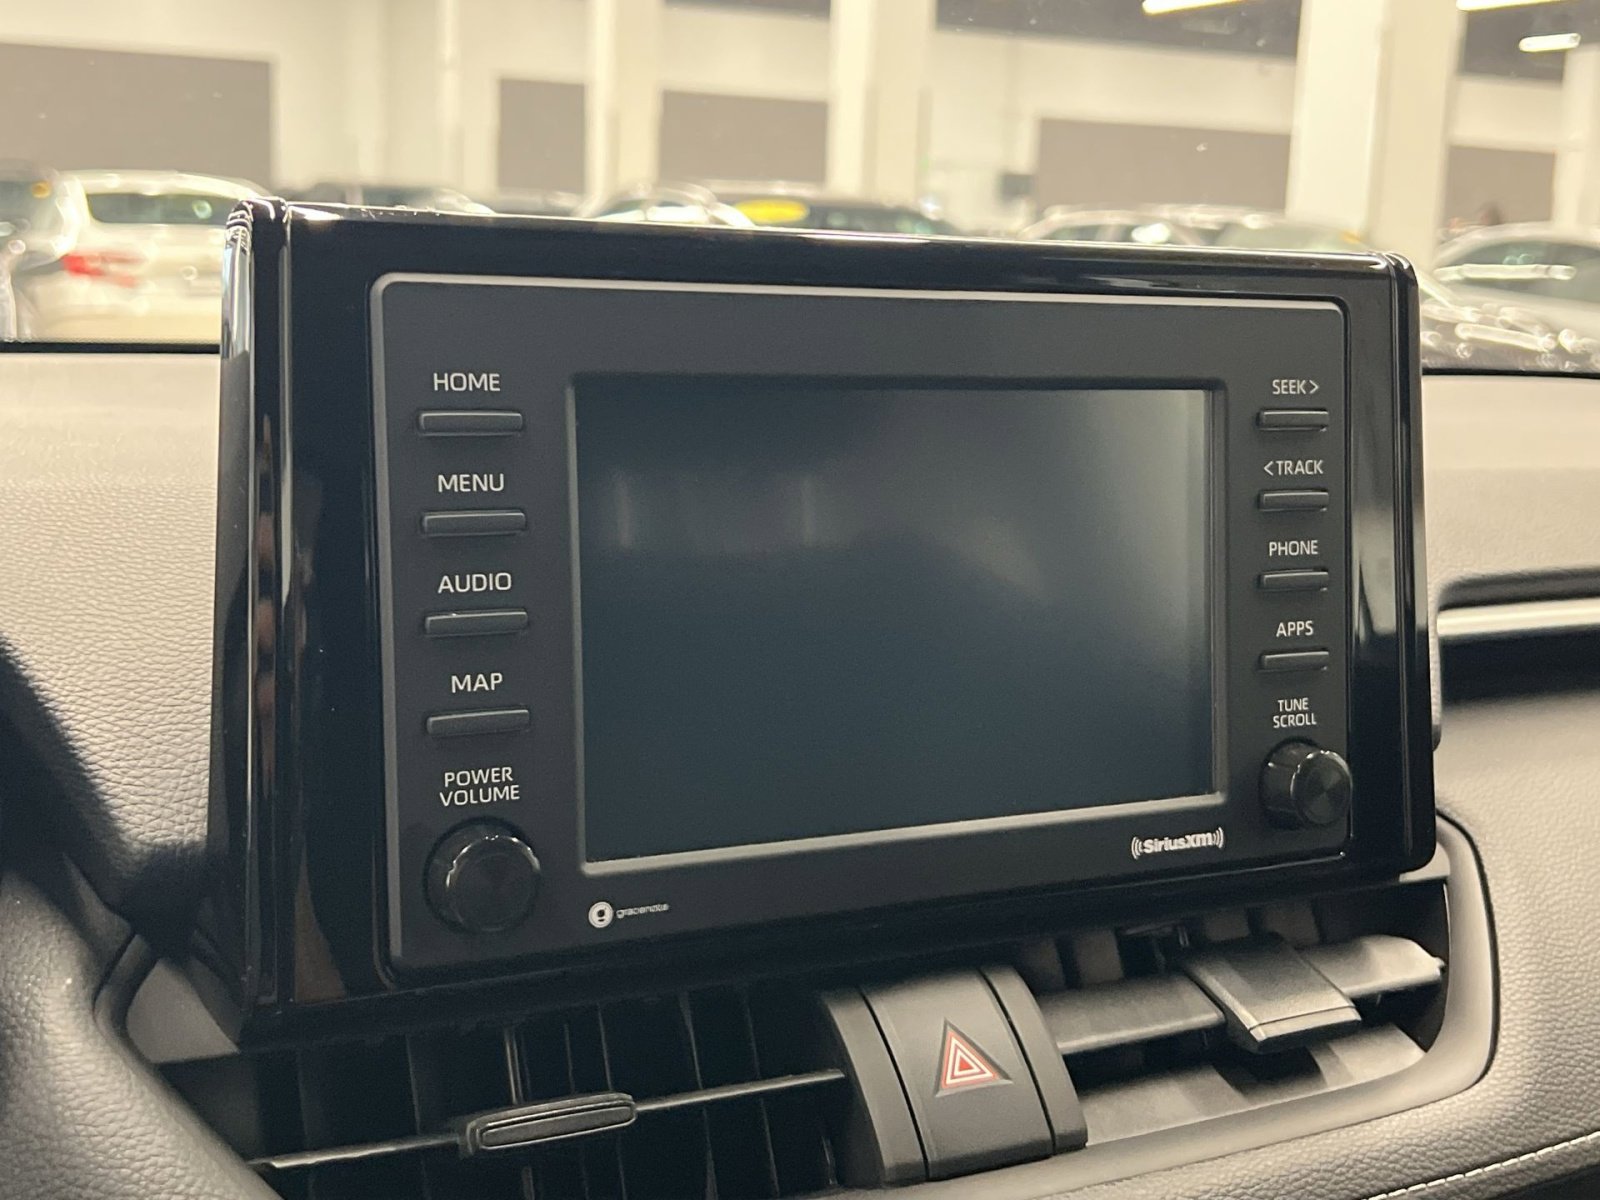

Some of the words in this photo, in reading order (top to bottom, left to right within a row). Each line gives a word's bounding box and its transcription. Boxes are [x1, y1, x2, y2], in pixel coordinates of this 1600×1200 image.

[433, 372, 501, 392] HOME
[1272, 379, 1307, 395] SEEK
[1276, 459, 1324, 475] TRACK
[437, 473, 505, 493] MENU
[1268, 540, 1319, 557] PHONE
[437, 572, 512, 594] AUDIO
[1276, 620, 1315, 638] APPS
[451, 672, 503, 693] MAP
[1277, 697, 1310, 712] TUNE
[1272, 712, 1317, 729] SCROLL
[443, 766, 514, 788] POWER
[439, 785, 520, 807] VOLUME
